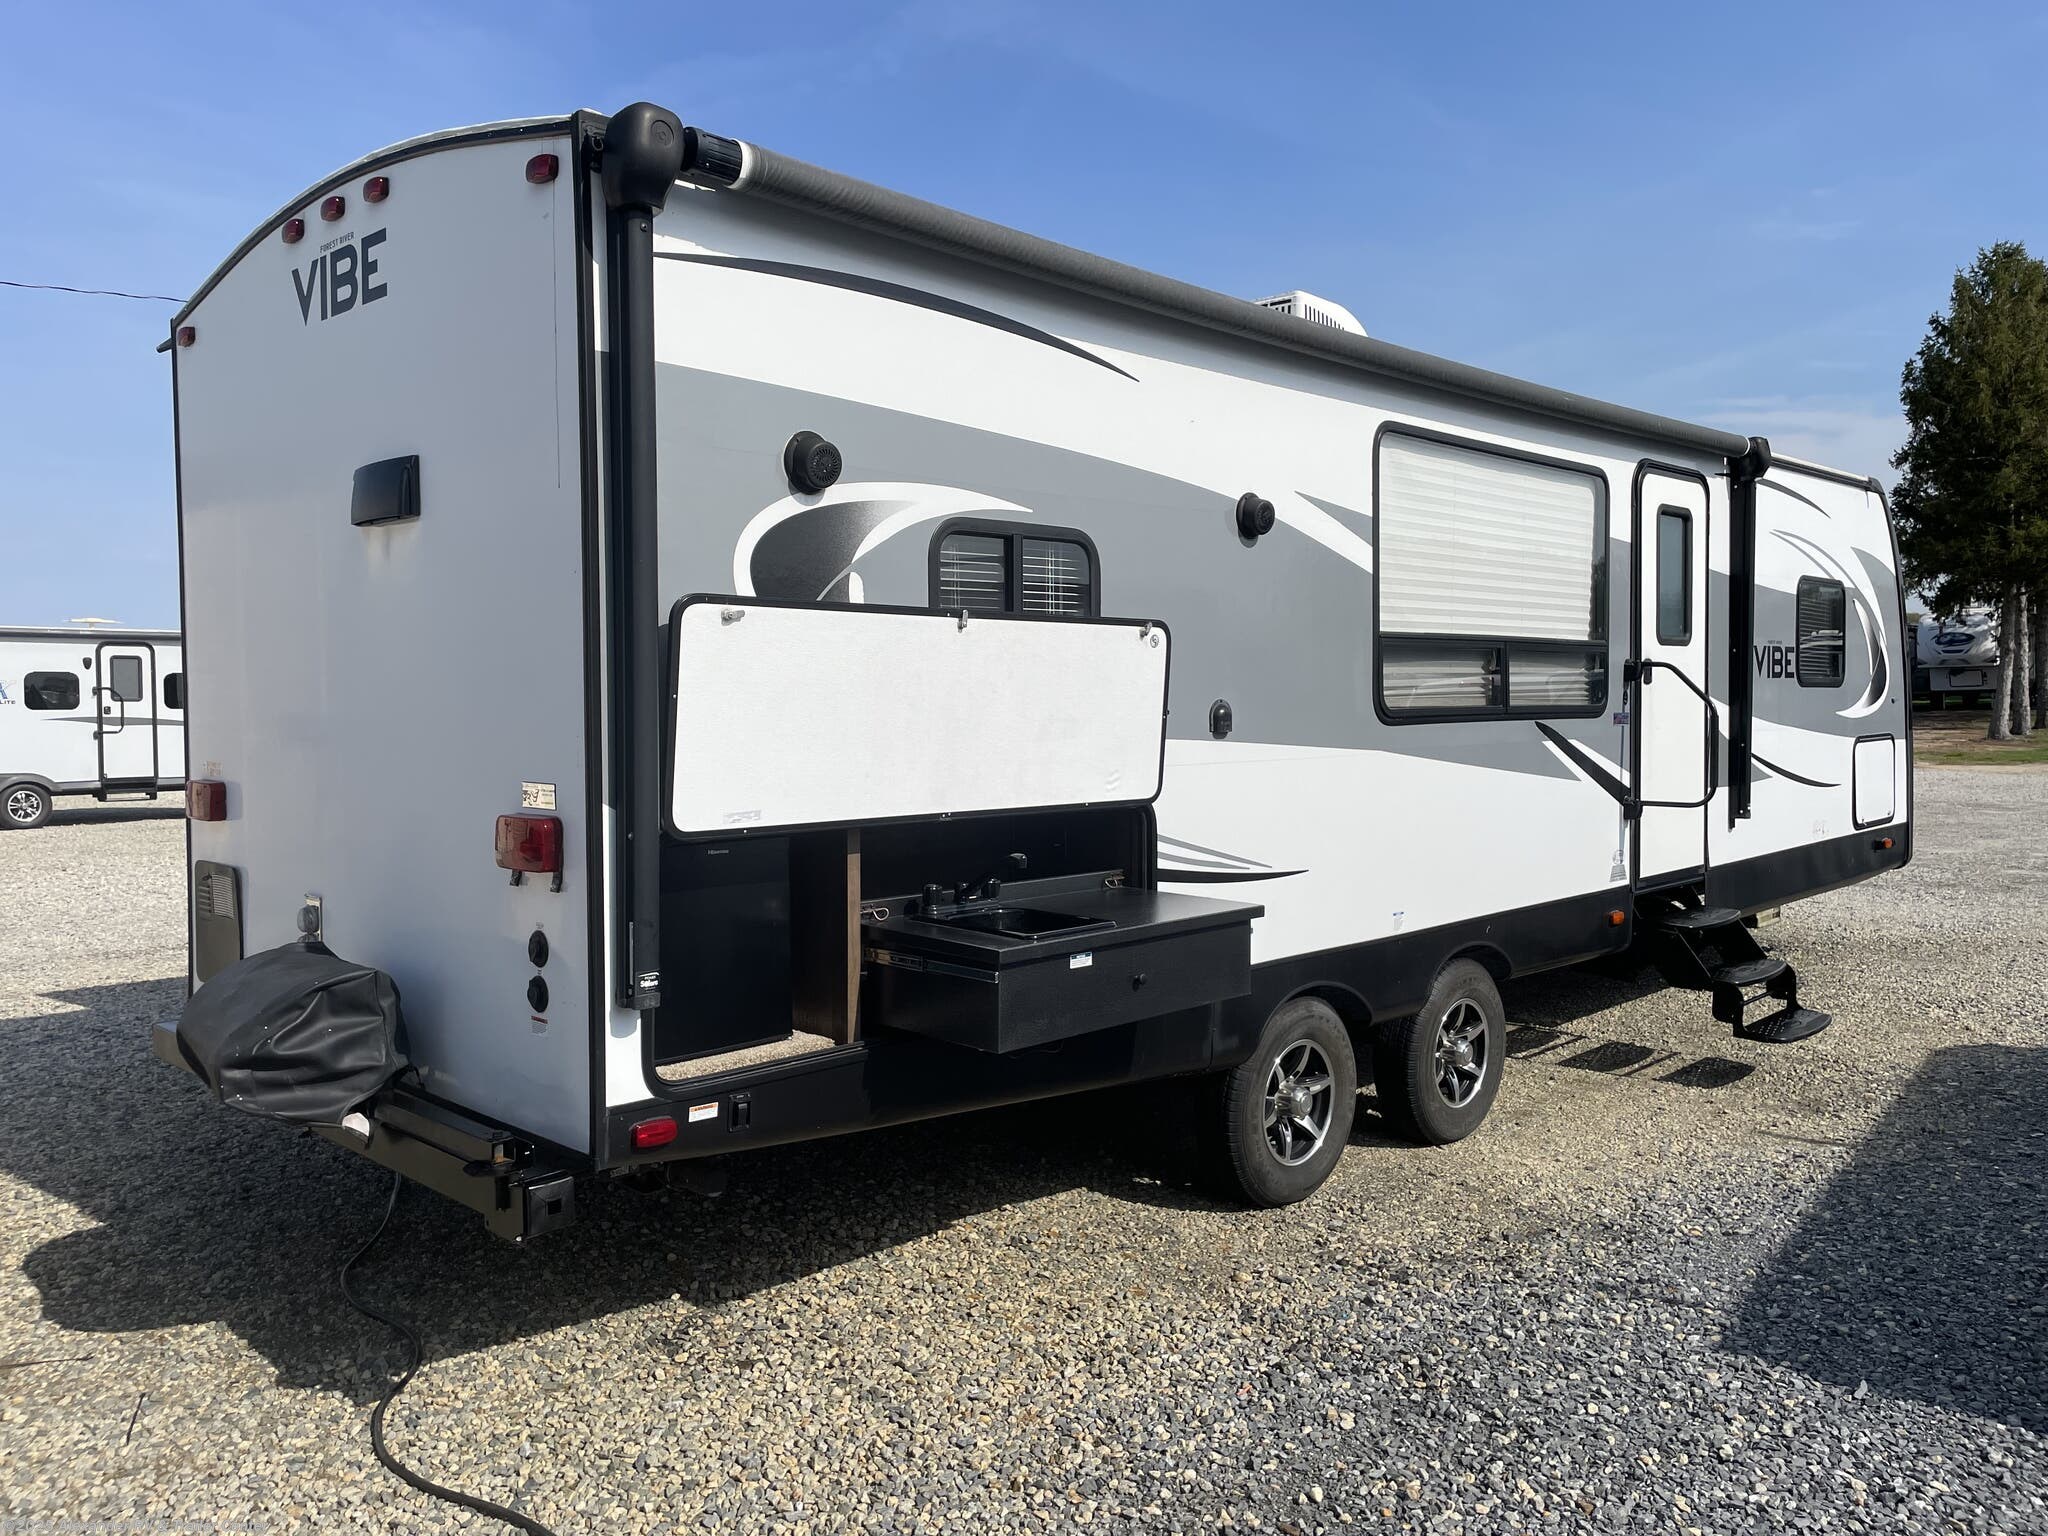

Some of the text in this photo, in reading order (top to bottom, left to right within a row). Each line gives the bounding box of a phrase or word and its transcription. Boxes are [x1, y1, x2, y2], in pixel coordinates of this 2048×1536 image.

[319, 231, 355, 254] FOREST RIVER
[291, 227, 388, 327] VIBE
[1753, 645, 1795, 679] VIBE
